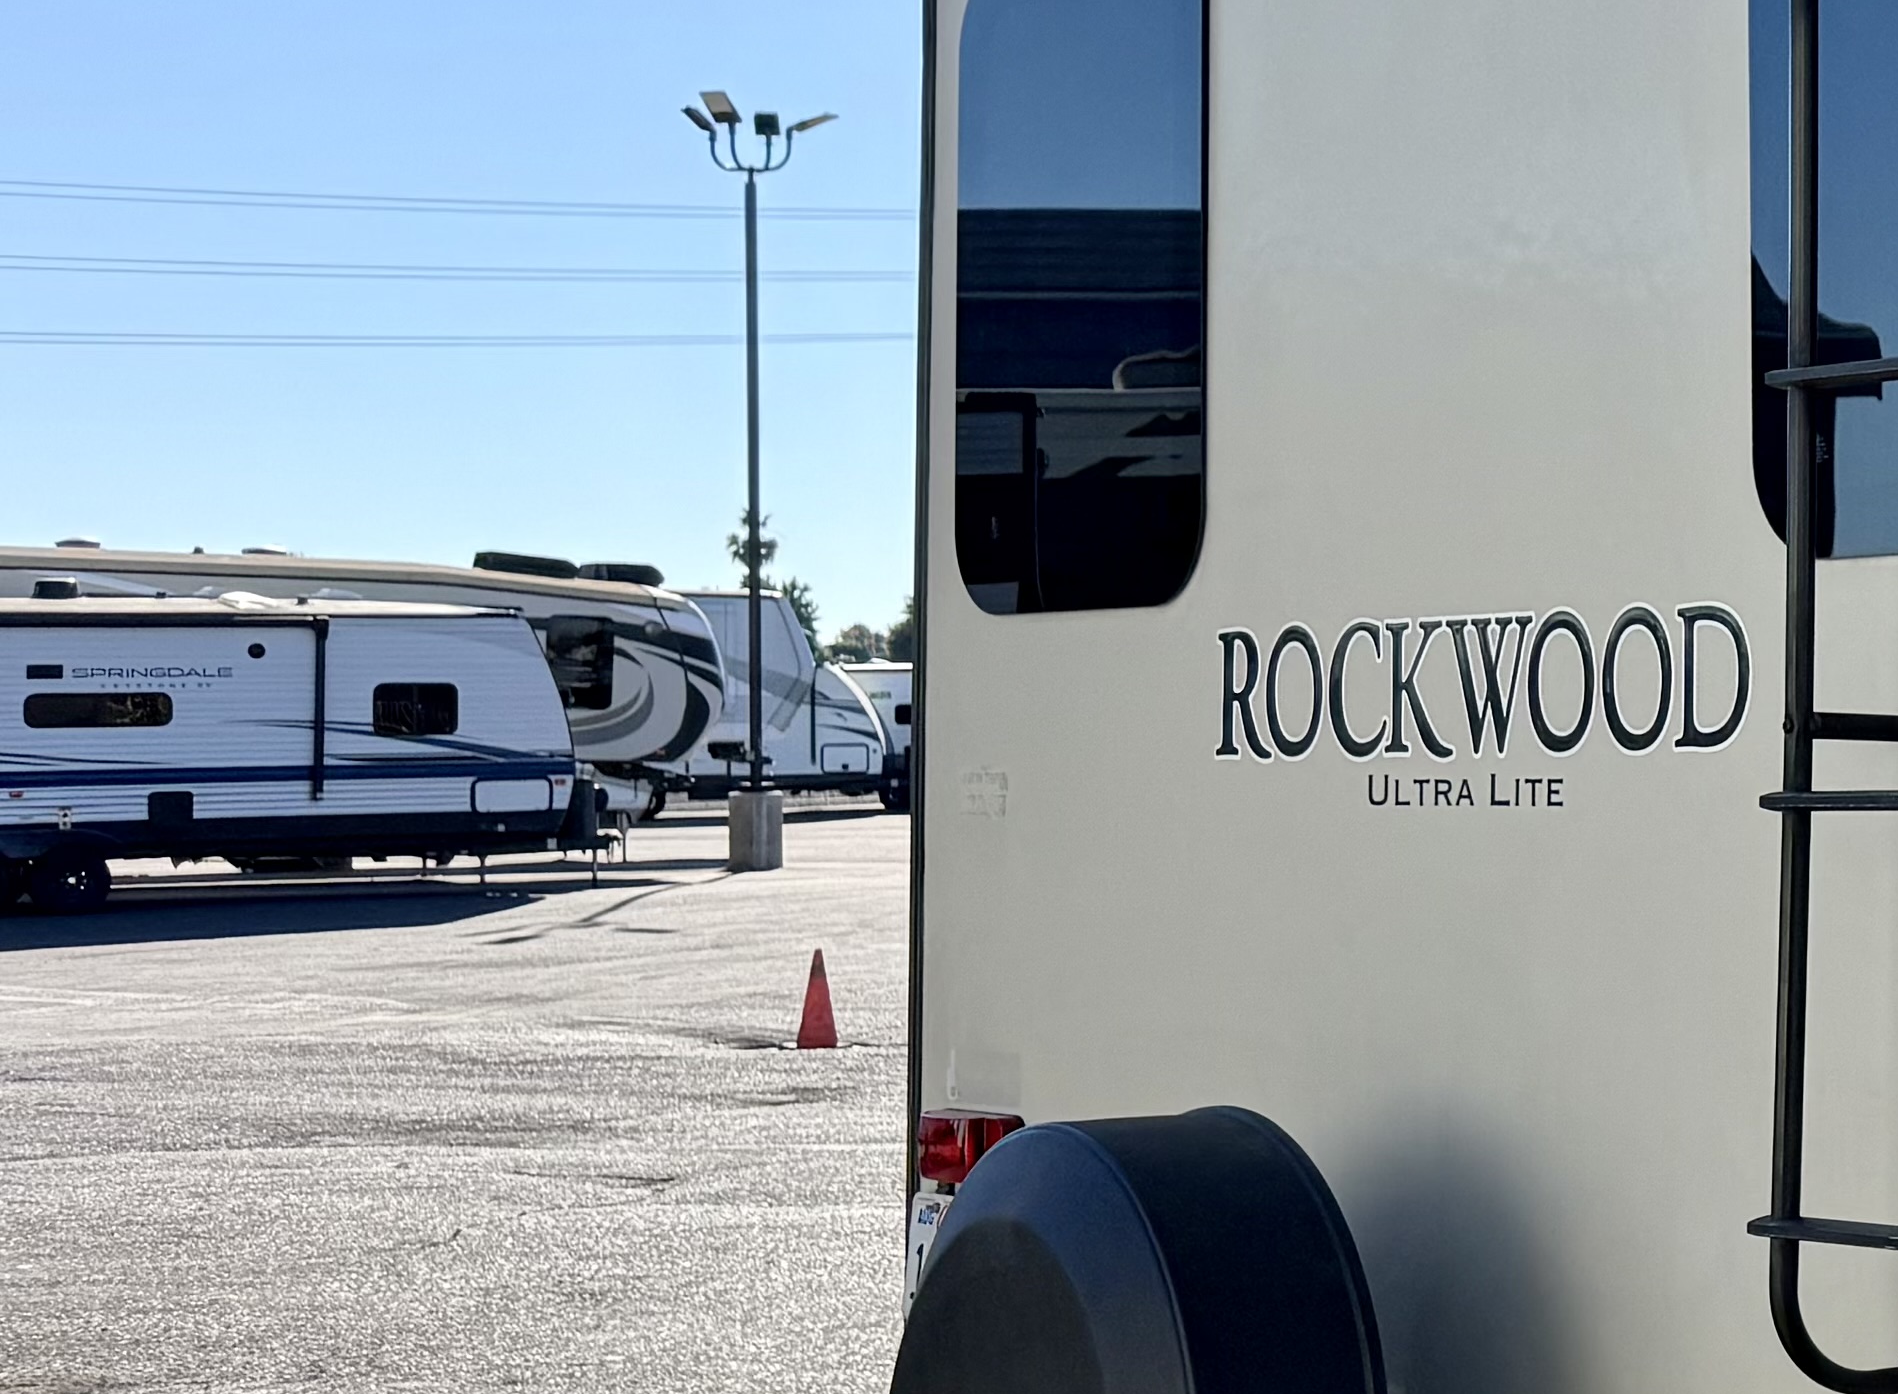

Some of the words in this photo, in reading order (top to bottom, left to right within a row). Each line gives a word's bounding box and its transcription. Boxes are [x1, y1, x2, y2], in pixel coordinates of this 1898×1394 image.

[71, 666, 233, 679] SPRINGDALE
[1215, 603, 1751, 761] ROCKWOOD
[1367, 773, 1475, 807] ULTRA
[1489, 772, 1564, 807] LITE
